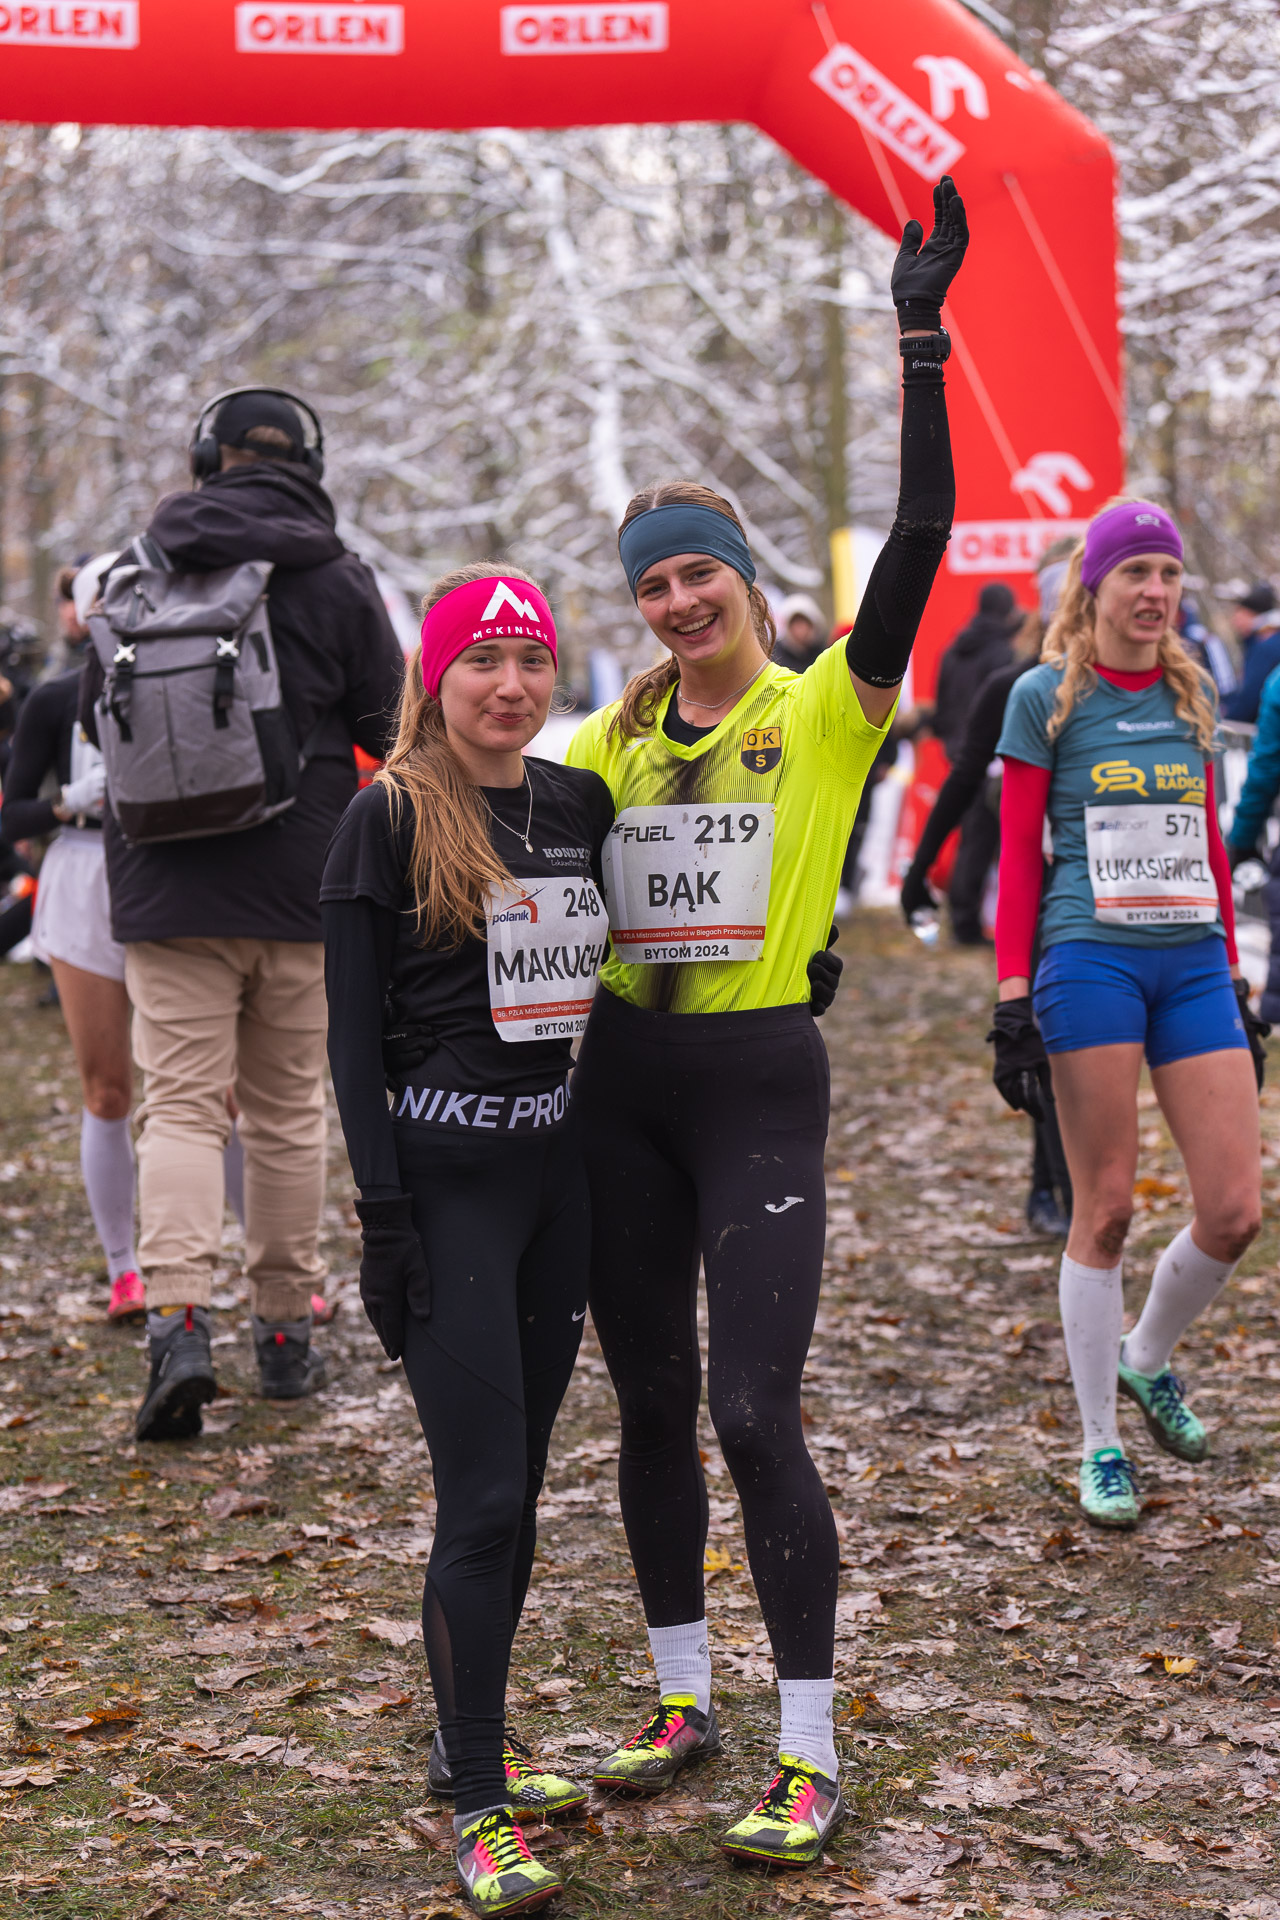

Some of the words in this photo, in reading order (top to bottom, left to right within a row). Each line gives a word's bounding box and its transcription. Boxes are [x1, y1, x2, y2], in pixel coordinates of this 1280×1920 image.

[250, 14, 388, 44] ORLEN
[515, 14, 652, 44] ORLEN
[829, 63, 945, 166] ORLEN
[755, 754, 767, 768] S
[1154, 763, 1189, 777] RUN
[1156, 776, 1206, 791] RADICA
[623, 825, 676, 843] FUEL
[694, 813, 760, 844] 219
[1165, 814, 1200, 837] 571
[647, 870, 722, 913] BĄK
[563, 887, 600, 918] 248
[492, 910, 529, 925] polanik
[1126, 911, 1169, 921] BYTOM
[1173, 910, 1199, 920] 2024
[636, 930, 669, 939] Mistrzostwa
[670, 929, 688, 937] Polski
[696, 929, 722, 938] Biegach
[644, 946, 691, 960] BYTOM
[694, 944, 730, 958] 2024
[494, 943, 603, 986] MAKUCH
[524, 1005, 558, 1015] Mistrzostwa
[534, 1021, 574, 1036] BYTOM
[575, 1019, 587, 1032] 202
[397, 1085, 505, 1129] NIKE
[507, 1085, 564, 1129] PRO
